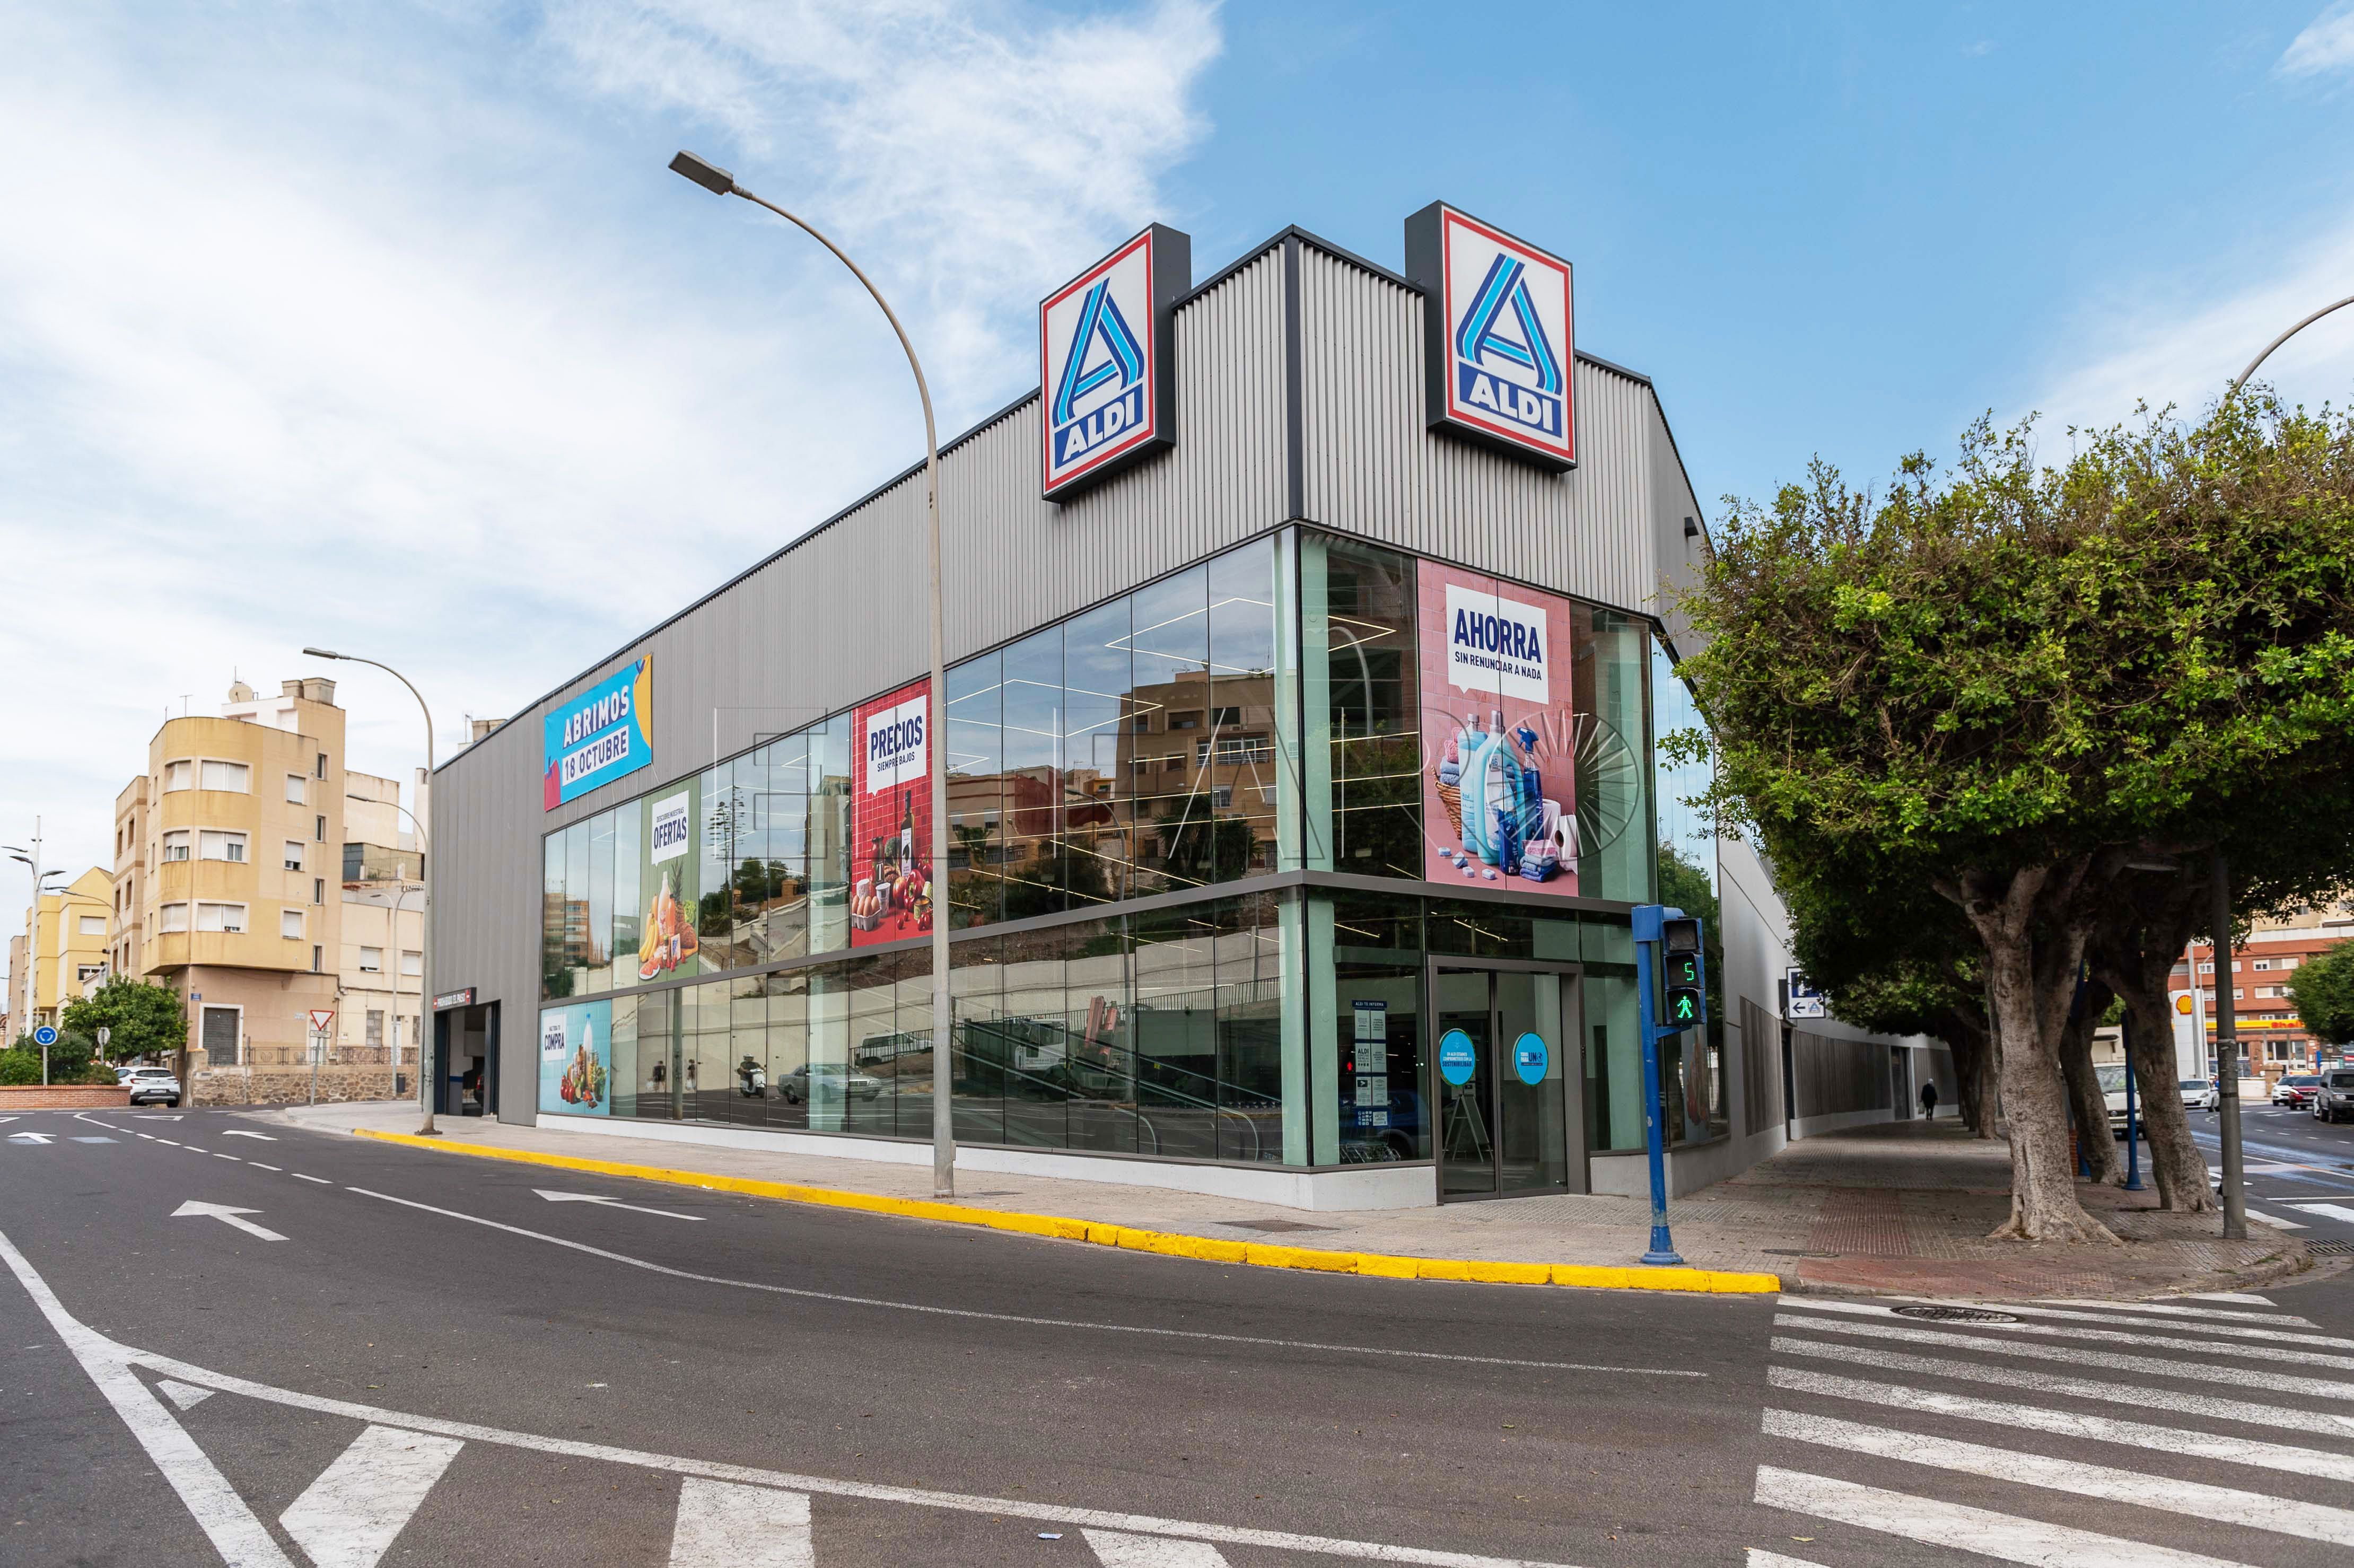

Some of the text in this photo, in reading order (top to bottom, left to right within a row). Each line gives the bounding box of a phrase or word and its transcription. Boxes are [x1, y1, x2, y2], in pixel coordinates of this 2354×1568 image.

[1469, 373, 1553, 431] ALDI
[1063, 392, 1135, 462] ALDI
[1454, 608, 1542, 663] AHORRA
[1455, 651, 1542, 680] SIN RENUNCIAR A NADA
[563, 685, 629, 749] ABRIMOS
[871, 715, 922, 761] PRECIOS
[565, 730, 627, 781] 18 OCTUBRE
[877, 751, 915, 772] SIEMPRE BAJOS
[657, 807, 684, 822] DESCUBRE NUESTRAS
[654, 817, 687, 849] OFERTAS
[1685, 962, 1694, 980] 5
[437, 995, 452, 1007] PROHIBIDO
[453, 994, 457, 1004] EL
[545, 1032, 564, 1050] COMPRA
